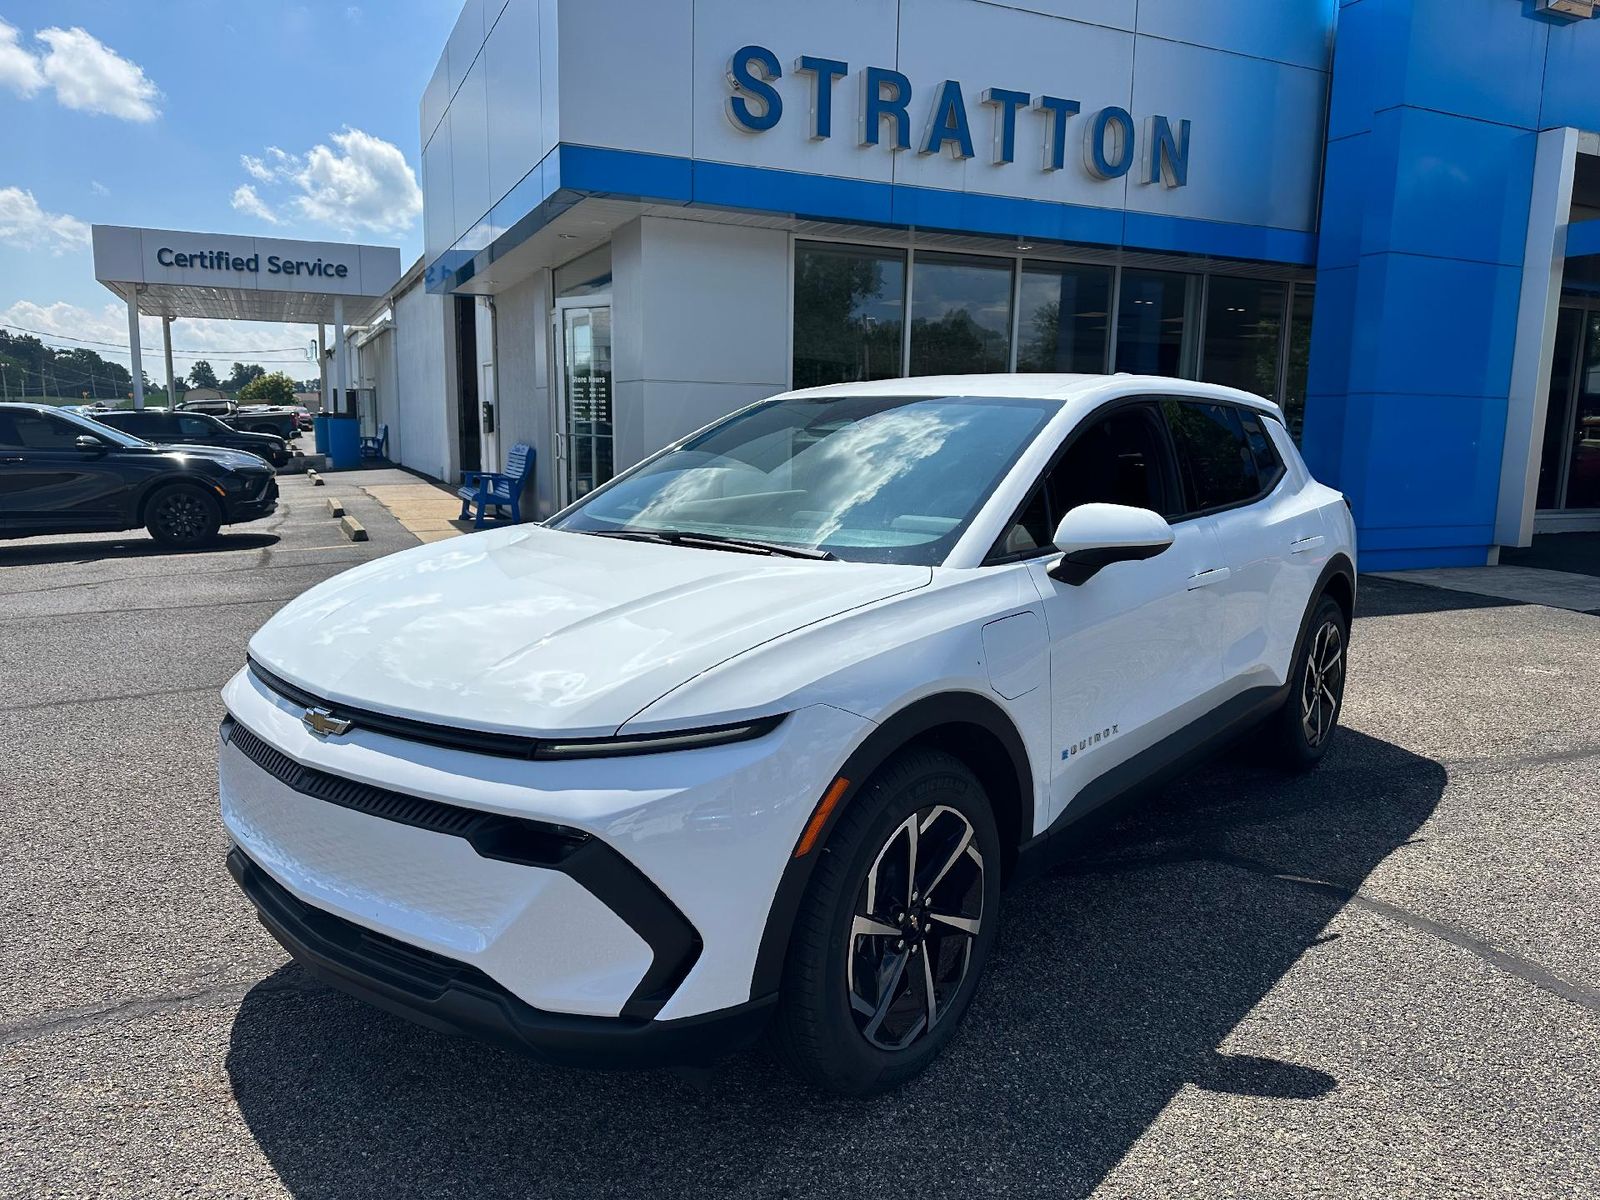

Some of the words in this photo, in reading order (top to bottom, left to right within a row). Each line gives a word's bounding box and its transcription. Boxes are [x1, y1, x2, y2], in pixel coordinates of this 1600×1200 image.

[727, 45, 1191, 189] STRATTON
[156, 248, 259, 273] Certified
[267, 255, 348, 278] Service
[1061, 724, 1119, 760] EQUINOX
